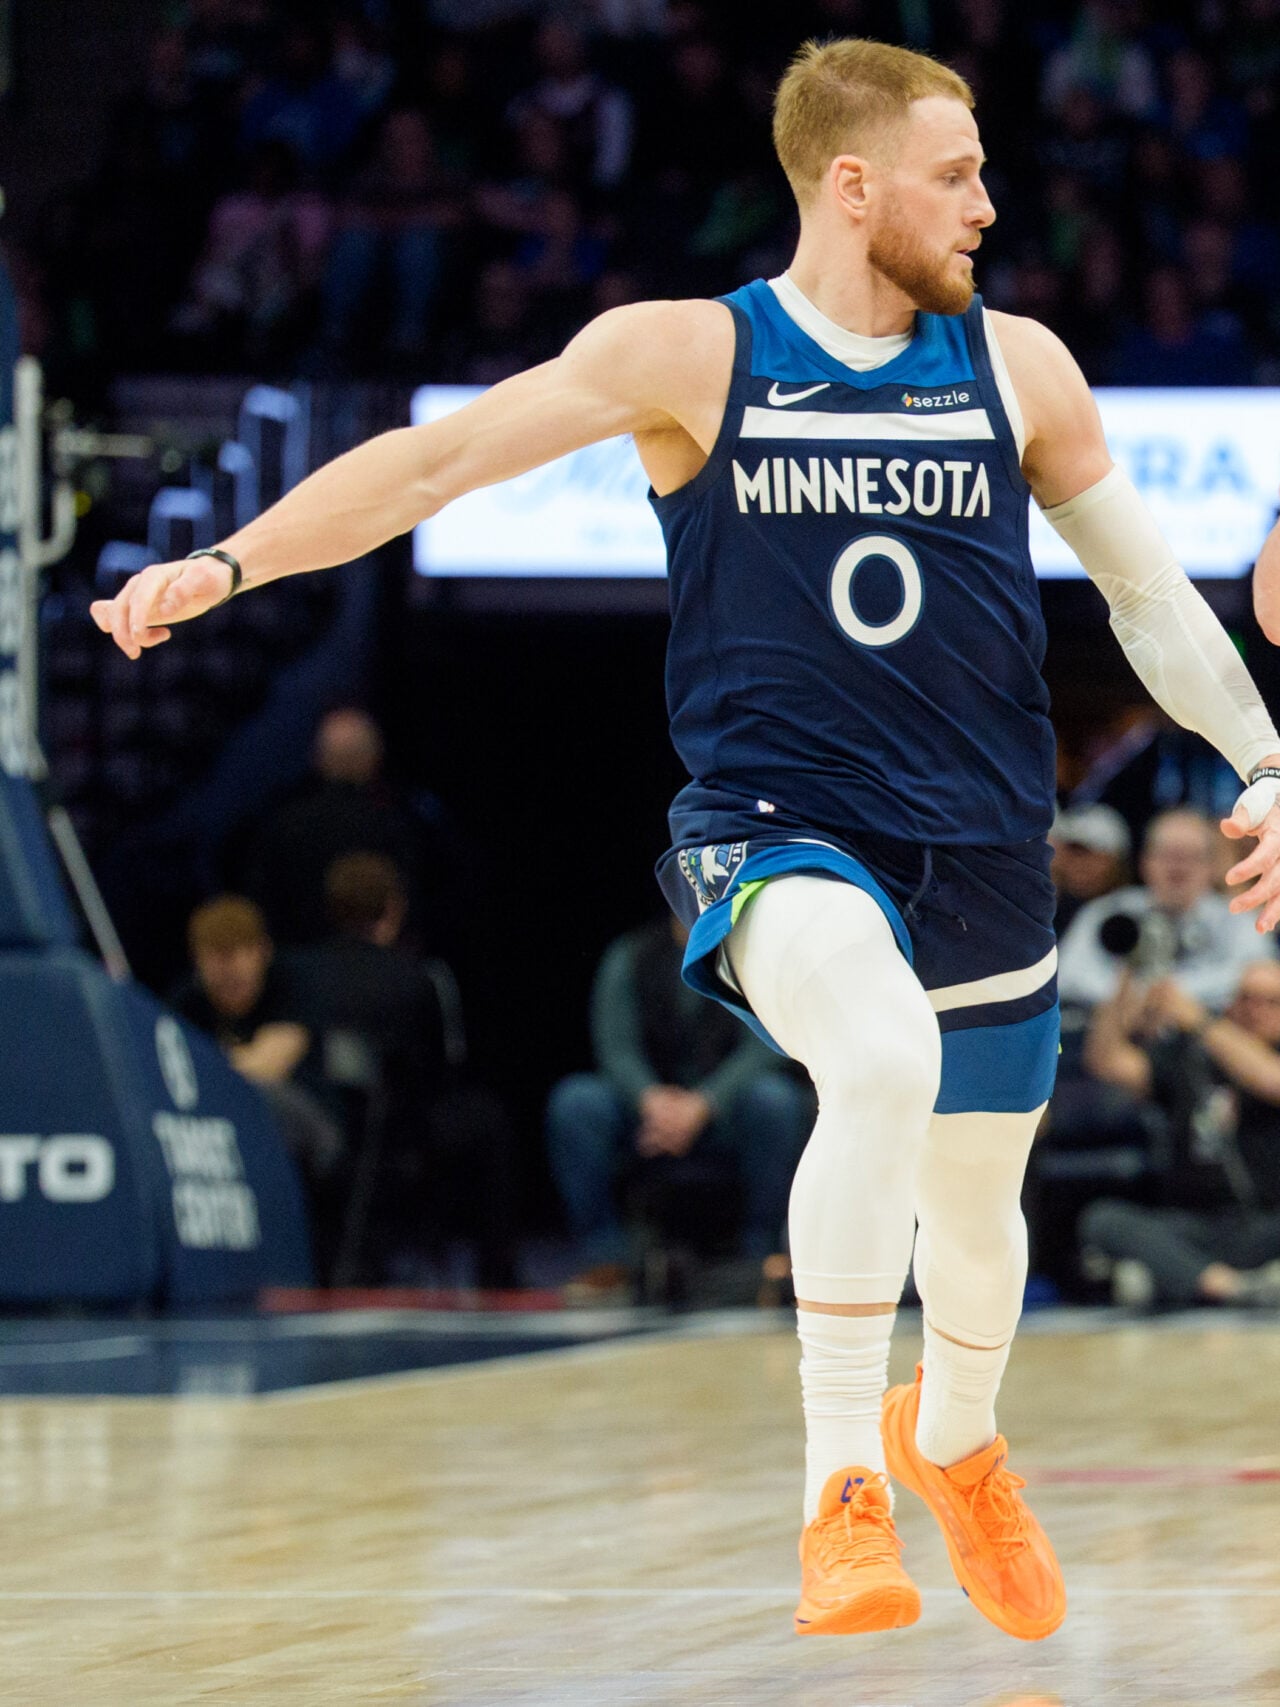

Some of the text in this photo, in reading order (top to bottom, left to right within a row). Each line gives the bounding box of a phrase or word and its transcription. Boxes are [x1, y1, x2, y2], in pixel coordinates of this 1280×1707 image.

[912, 390, 970, 408] sezzle
[732, 457, 990, 518] MINNESOTA
[829, 533, 924, 648] 0
